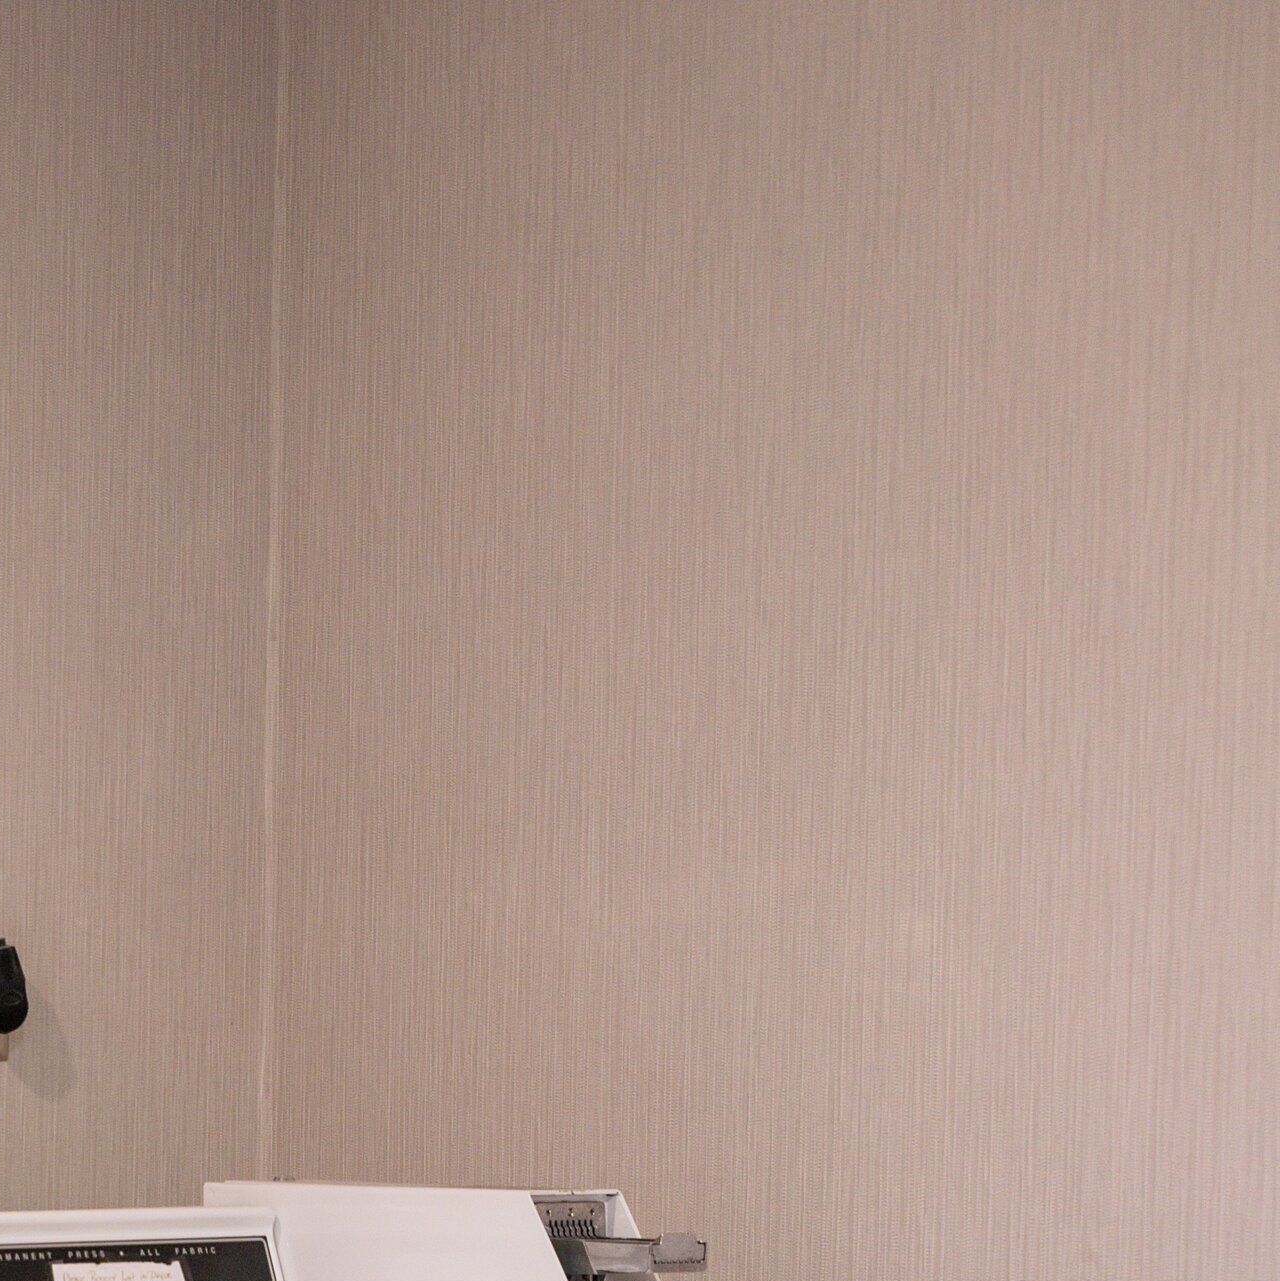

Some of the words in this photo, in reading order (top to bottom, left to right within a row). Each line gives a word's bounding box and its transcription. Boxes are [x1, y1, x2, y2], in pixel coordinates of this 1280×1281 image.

[68, 1250, 107, 1259] PRESS
[140, 1248, 161, 1257] ALL
[175, 1246, 218, 1256] FABRIC
